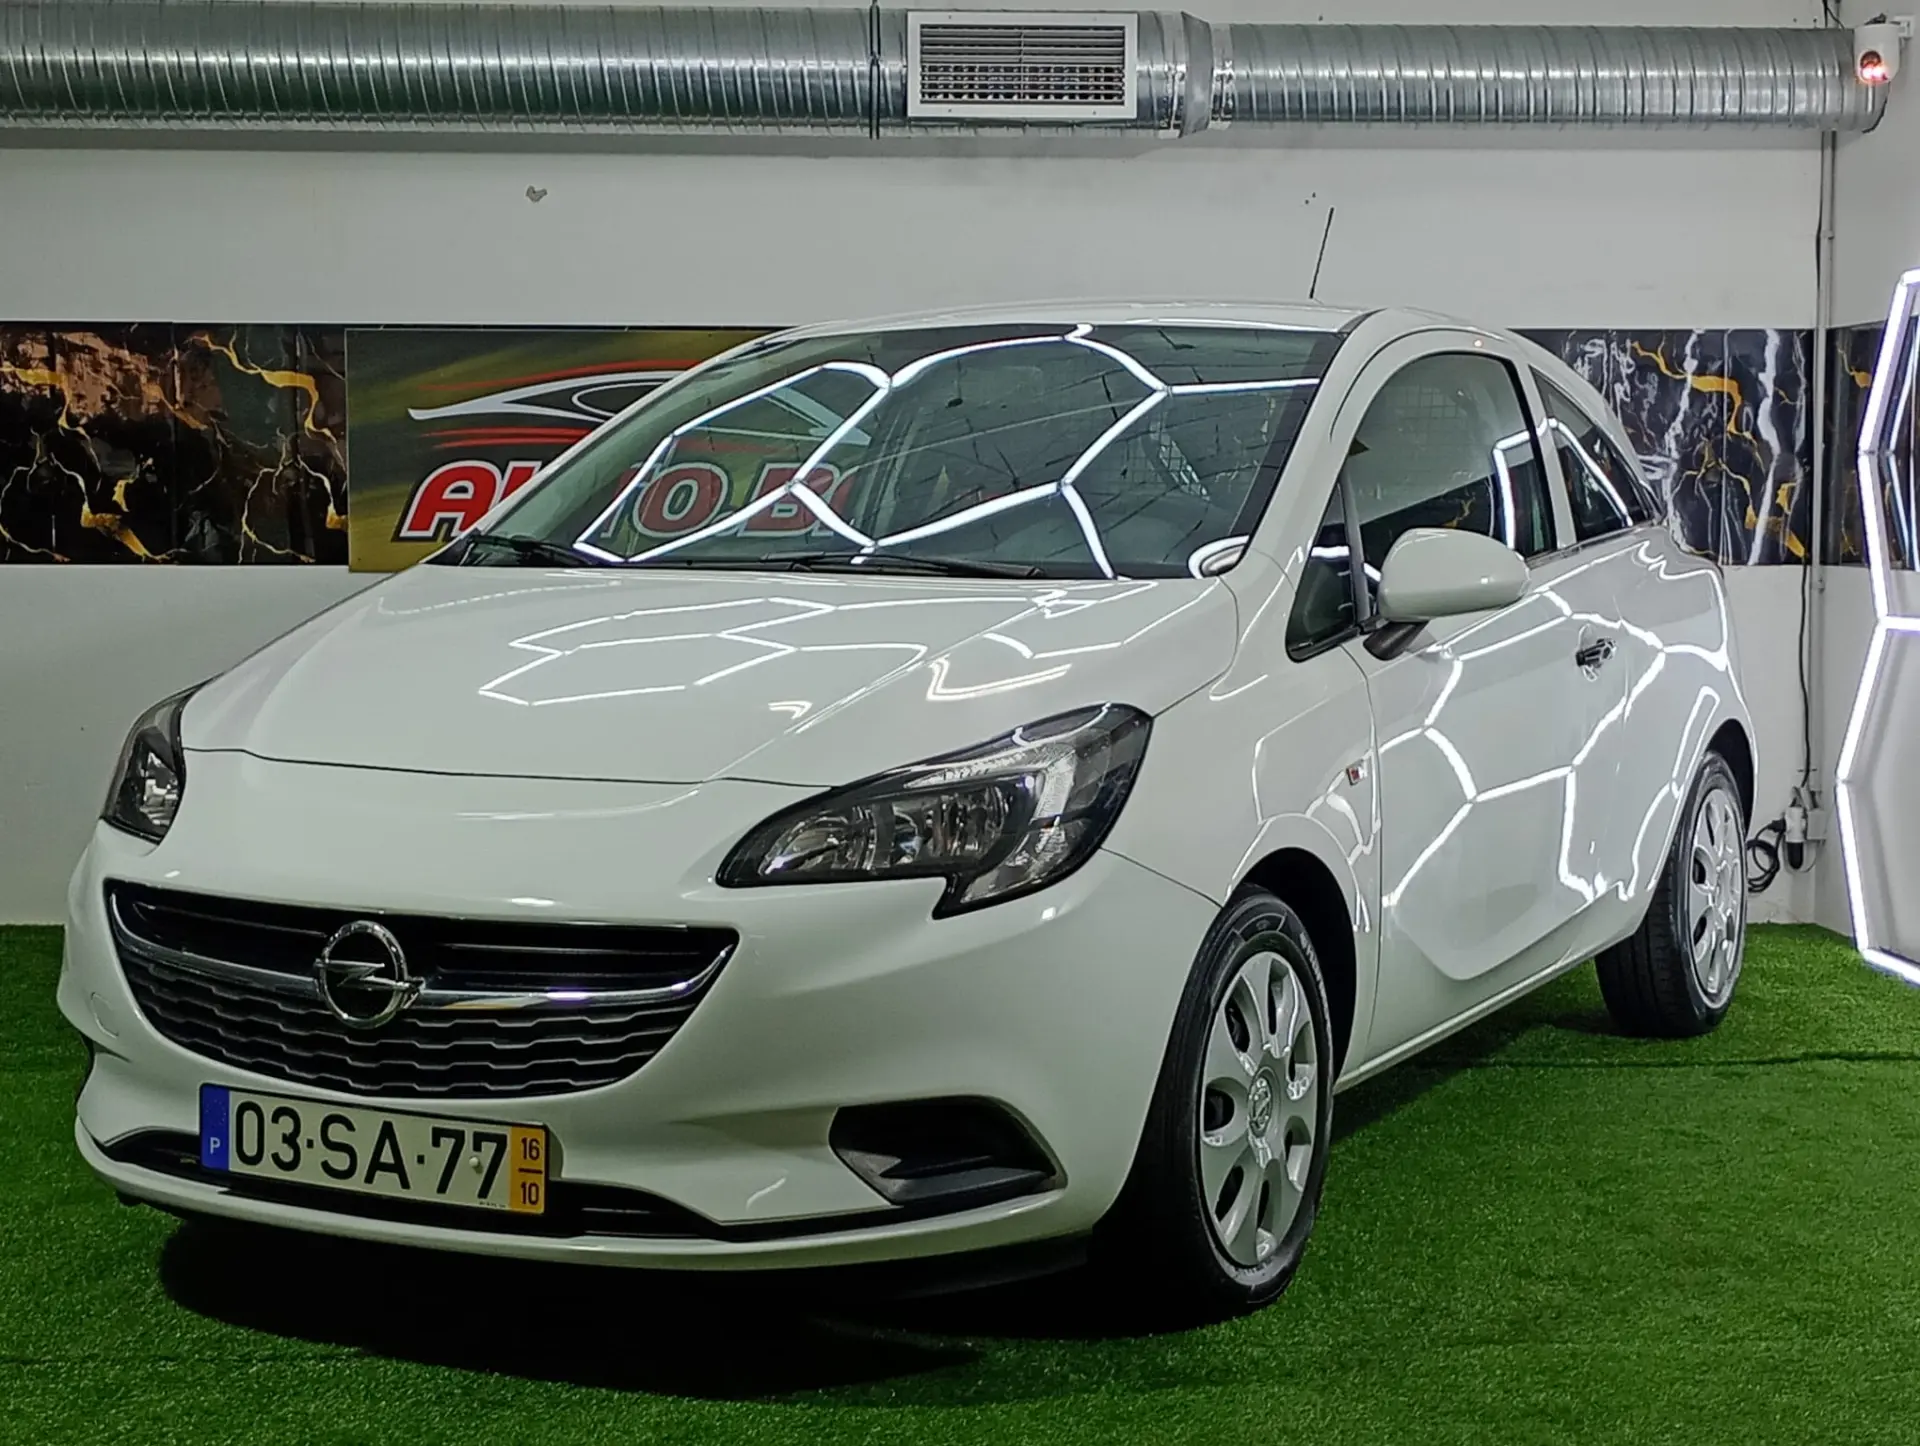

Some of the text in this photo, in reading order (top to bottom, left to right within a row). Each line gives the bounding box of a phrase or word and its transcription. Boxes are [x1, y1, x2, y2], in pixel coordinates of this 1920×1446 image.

[210, 1137, 221, 1155] P
[521, 1137, 541, 1161] 16
[520, 1182, 539, 1206] 10
